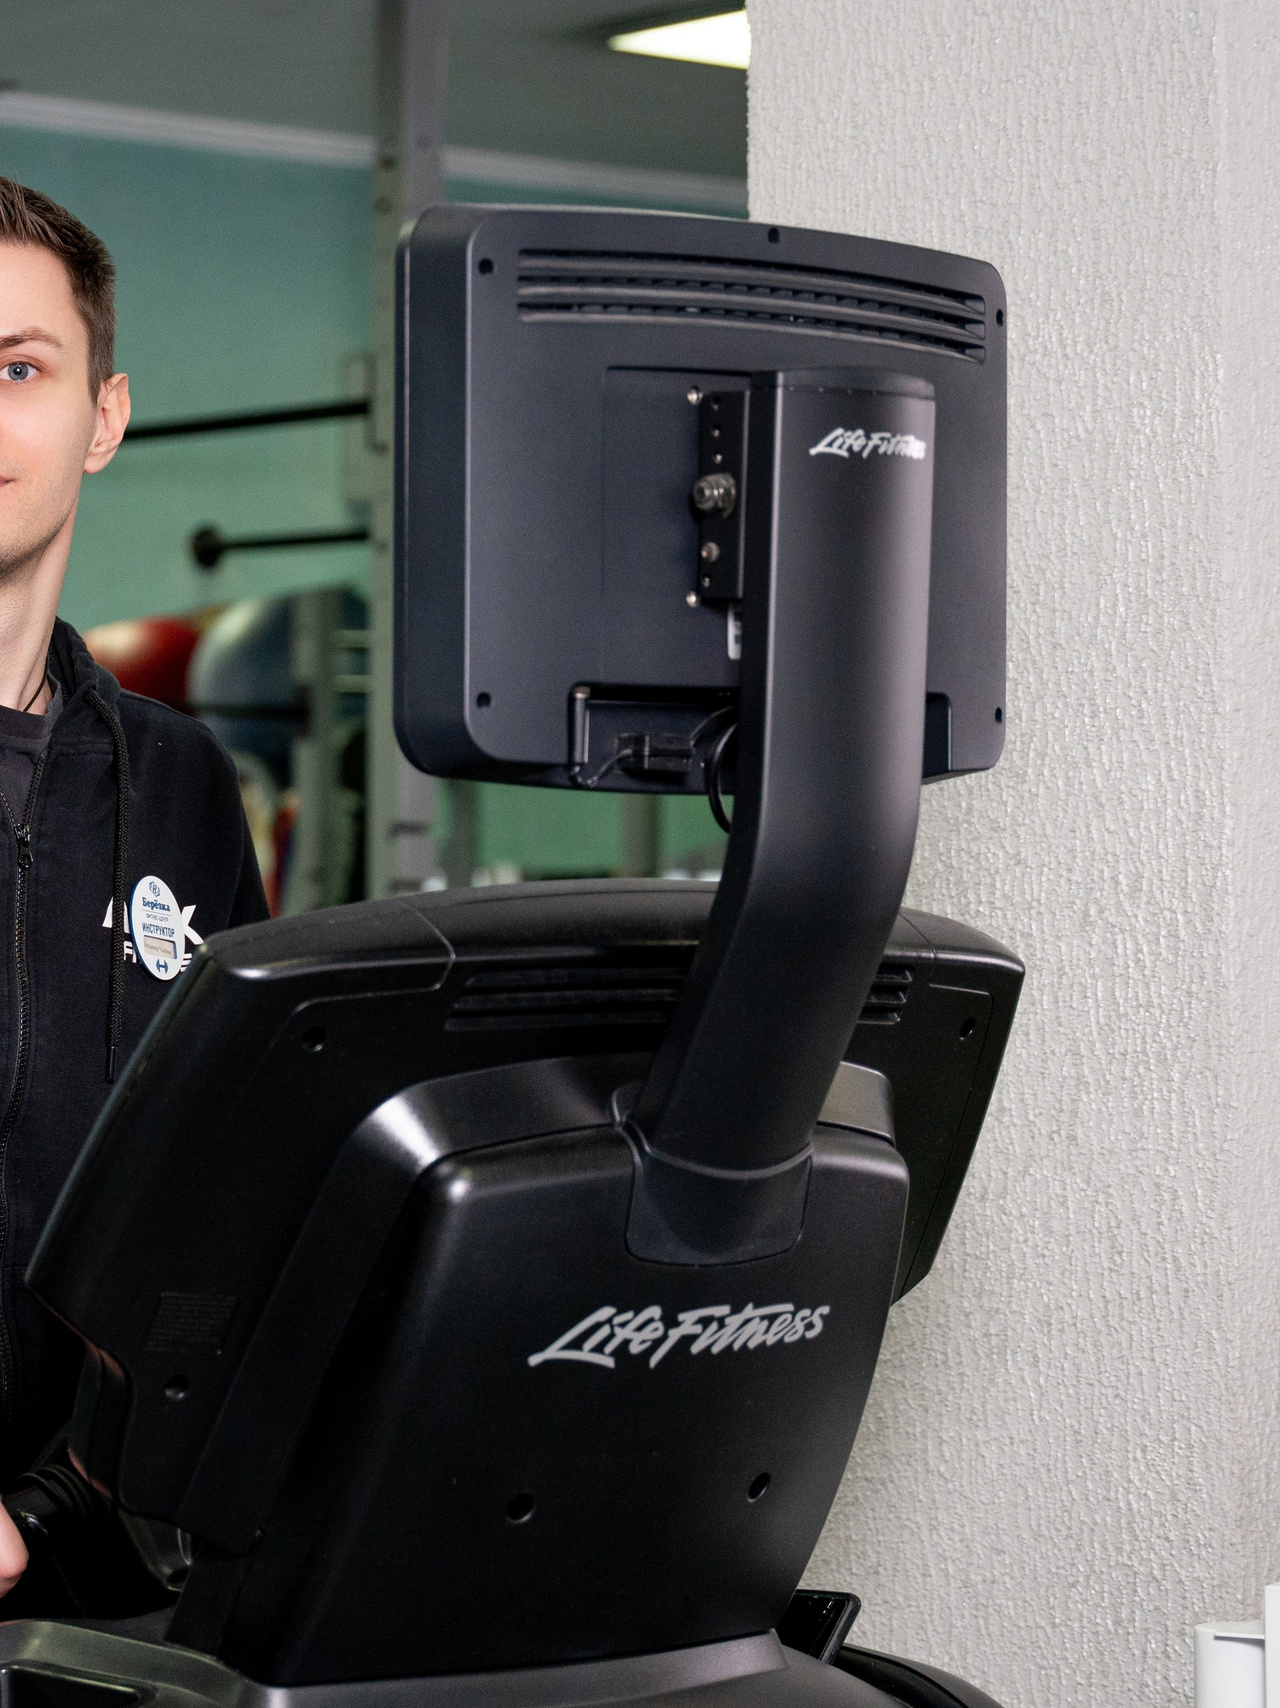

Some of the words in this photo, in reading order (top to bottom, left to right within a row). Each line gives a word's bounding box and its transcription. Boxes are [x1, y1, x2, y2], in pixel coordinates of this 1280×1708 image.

[809, 427, 866, 458] Life
[142, 922, 175, 938] ИНСТРУКТОР
[527, 1306, 664, 1368] Life
[649, 1302, 830, 1368] Fitness
